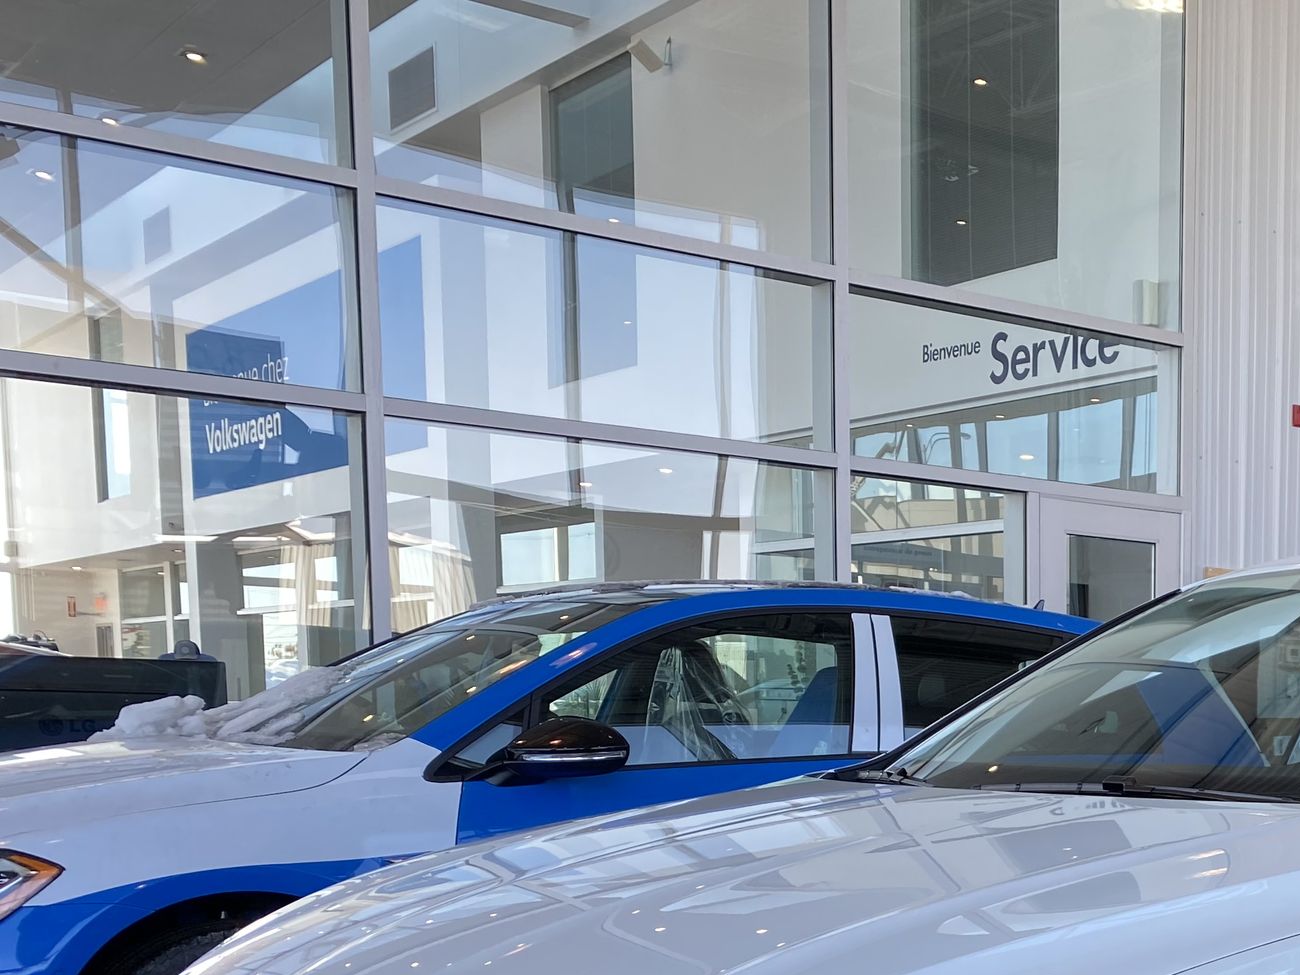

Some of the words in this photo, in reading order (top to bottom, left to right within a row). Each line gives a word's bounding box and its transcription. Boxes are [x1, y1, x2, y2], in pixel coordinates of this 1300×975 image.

[262, 353, 290, 384] chez
[922, 339, 981, 363] Bienvenue
[989, 331, 1120, 385] Service
[205, 411, 282, 454] Volkswagen
